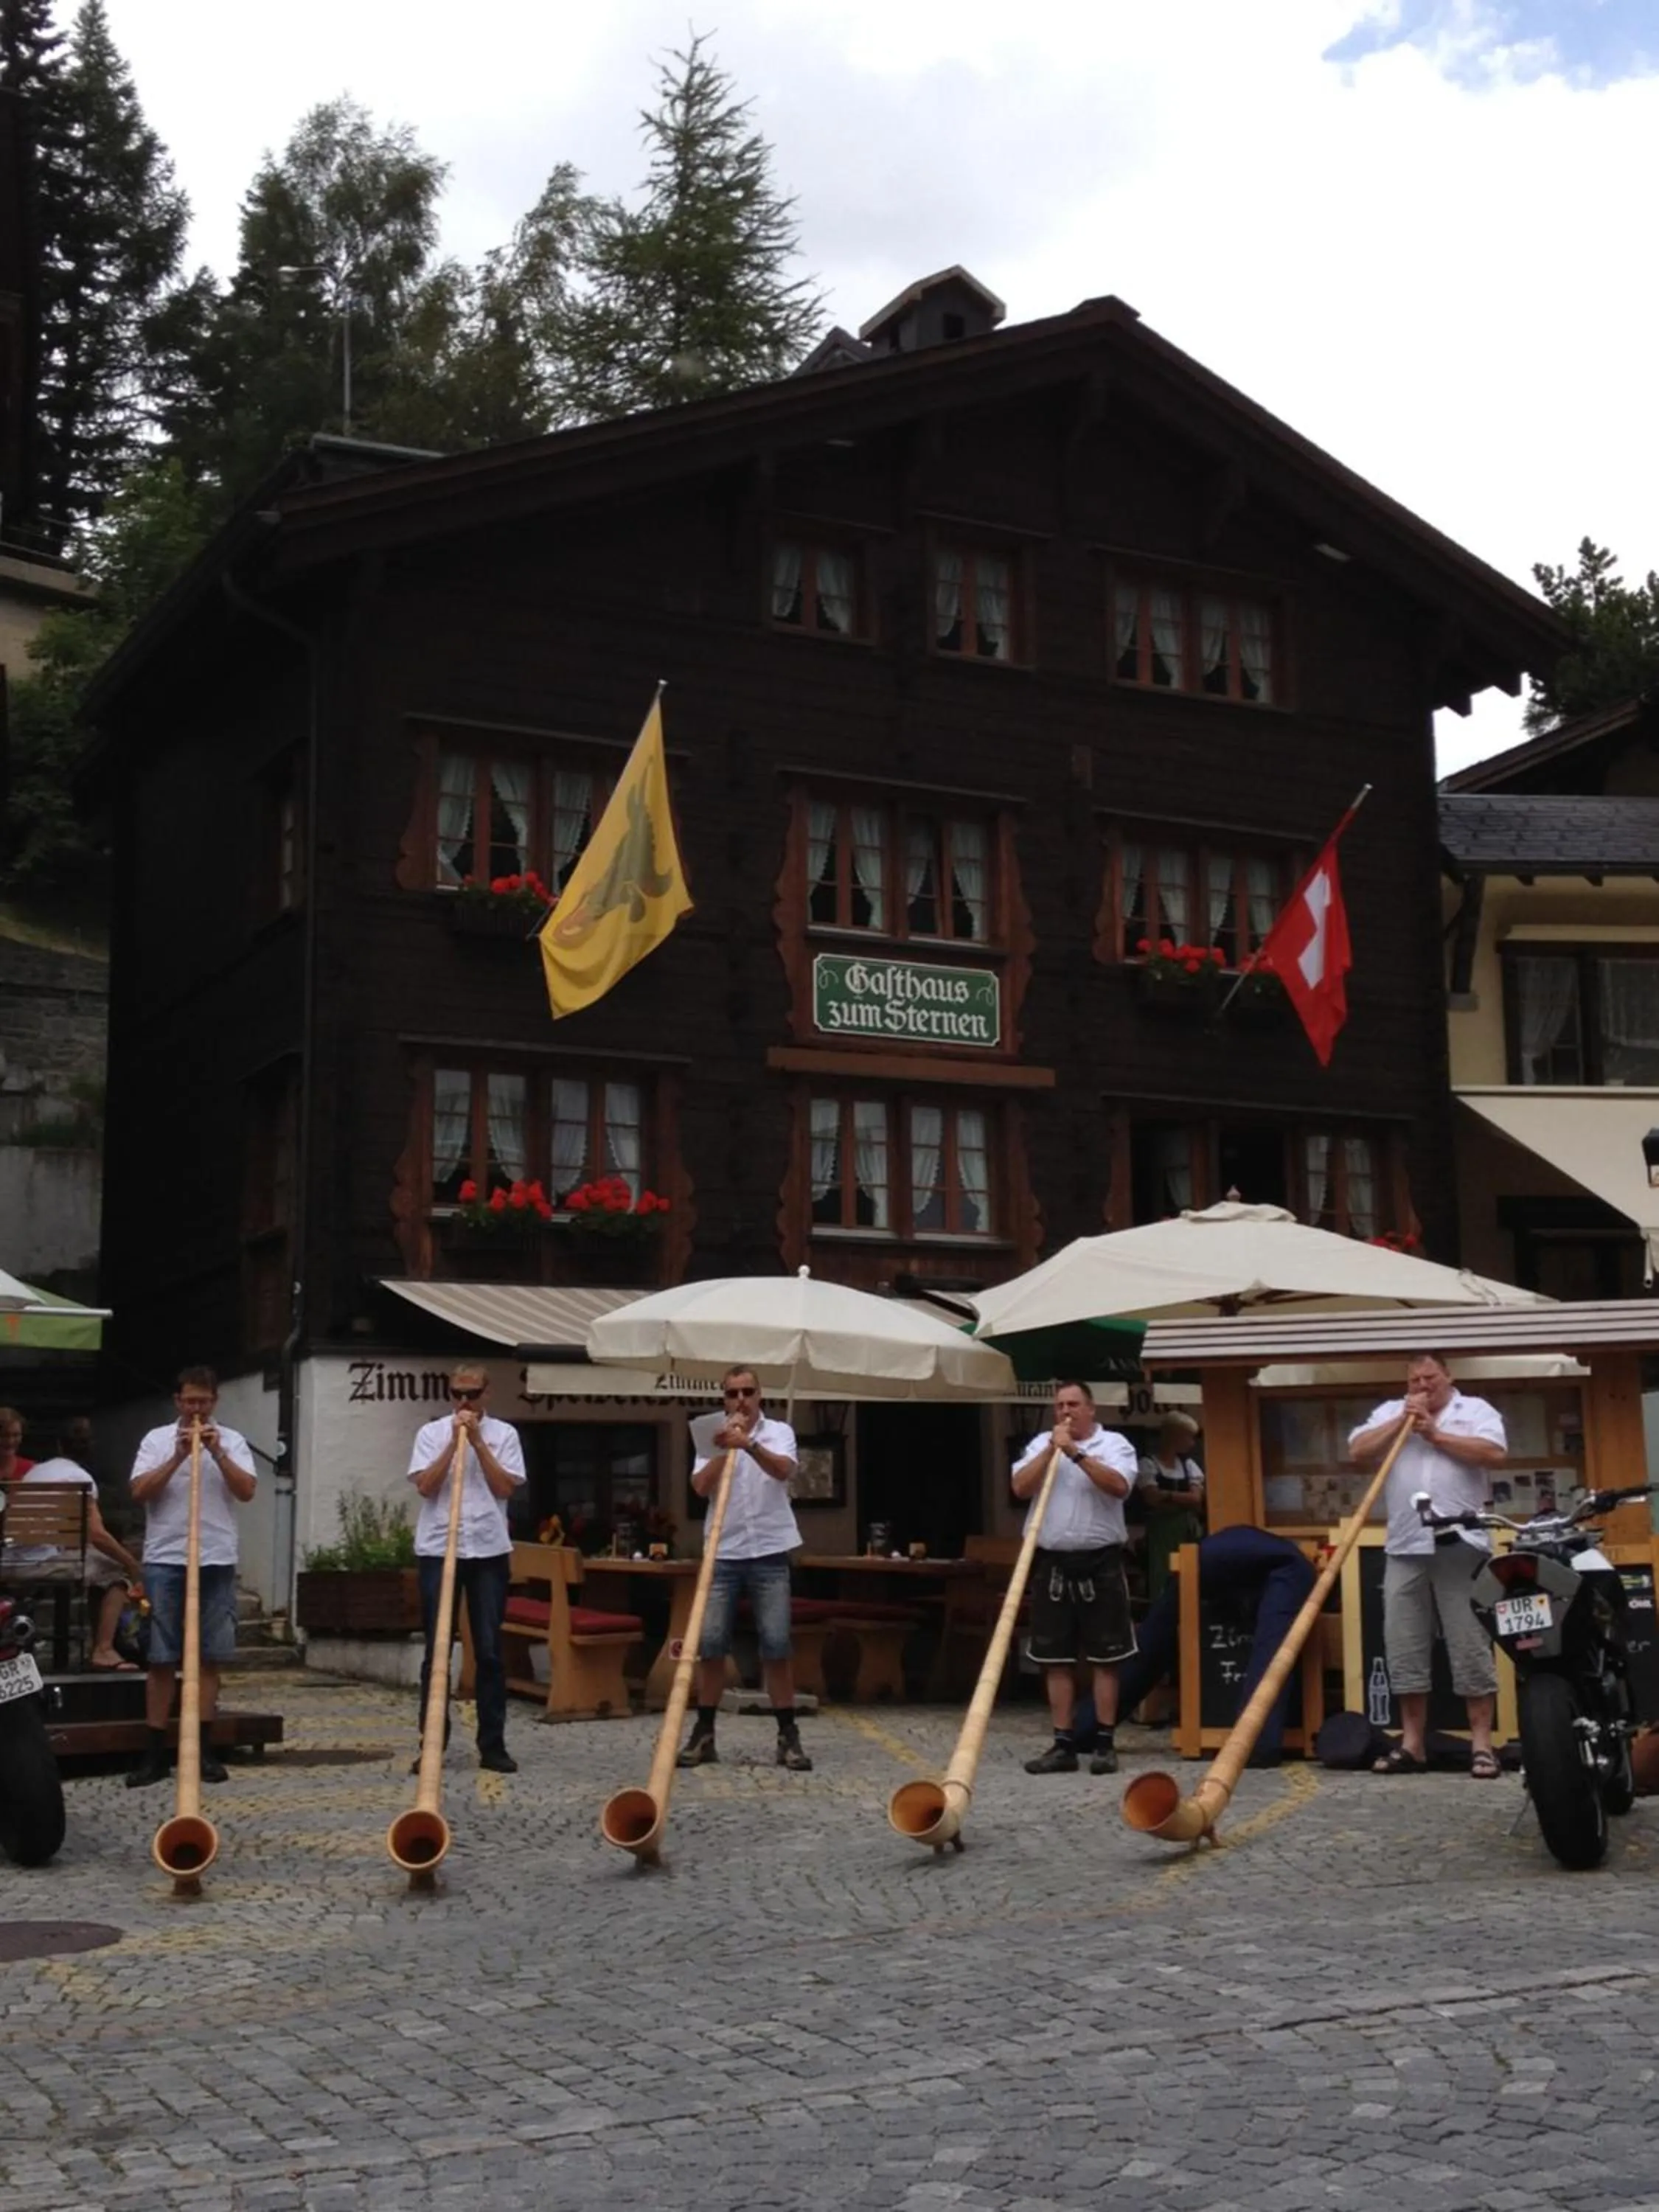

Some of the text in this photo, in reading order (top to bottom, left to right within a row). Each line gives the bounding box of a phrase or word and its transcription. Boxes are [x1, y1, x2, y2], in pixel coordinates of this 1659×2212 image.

[827, 998, 989, 1038] zum Sternen
[348, 1361, 451, 1402] Zimm
[1511, 1596, 1533, 1614] UR
[1505, 1611, 1545, 1632] 1794
